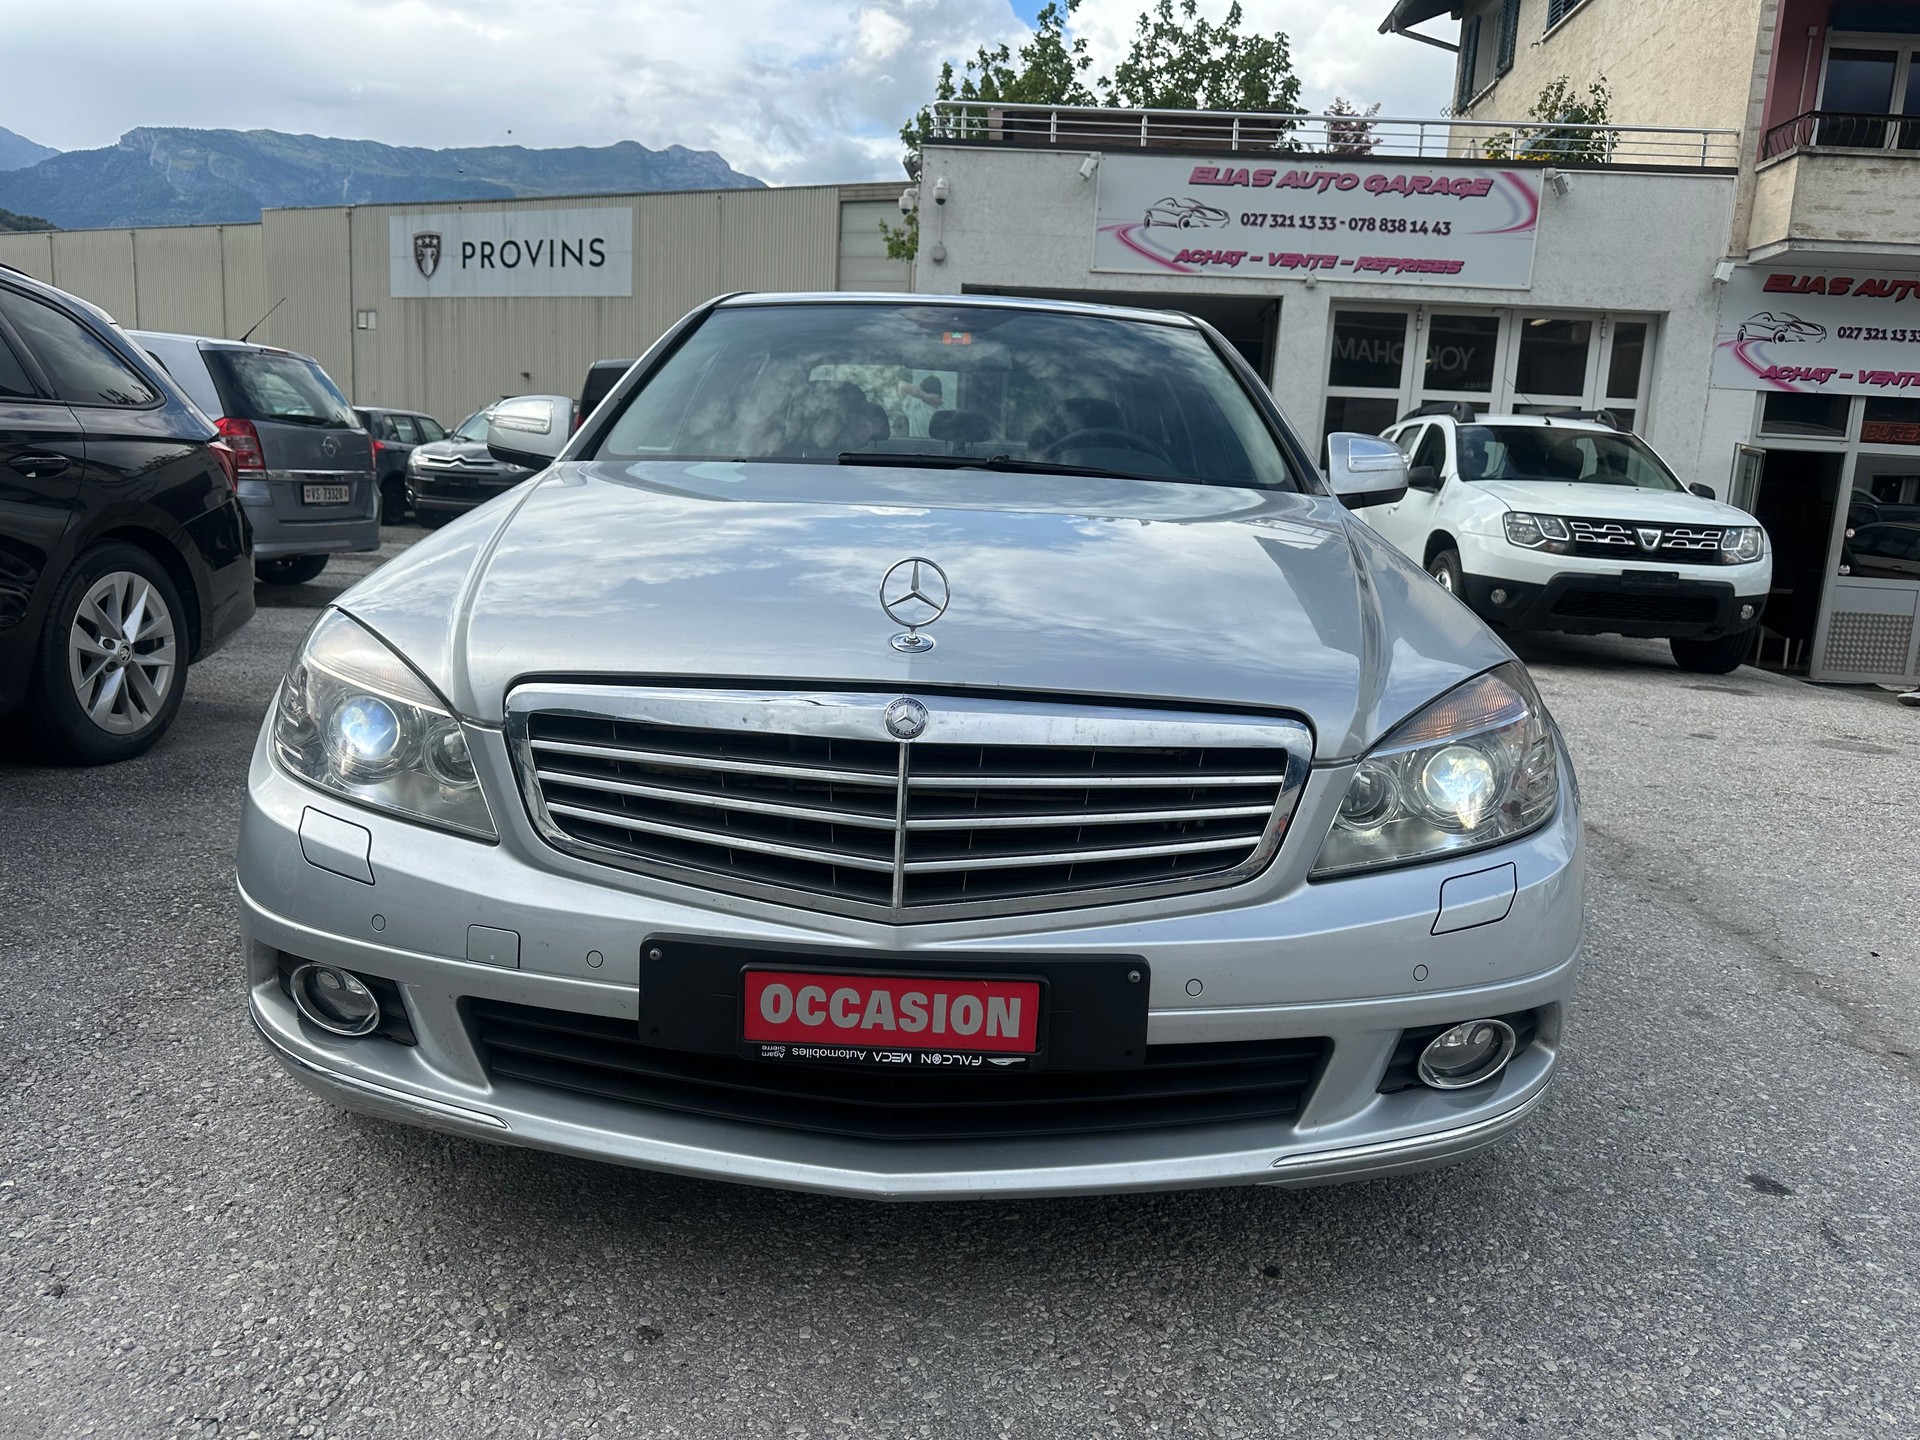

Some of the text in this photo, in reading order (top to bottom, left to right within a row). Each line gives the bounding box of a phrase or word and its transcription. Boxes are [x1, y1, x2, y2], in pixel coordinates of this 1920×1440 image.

[1188, 166, 1494, 200] ELIAS AUTO GARAGE
[1240, 212, 1267, 228] 027
[1269, 214, 1296, 229] 321
[1298, 215, 1316, 230] 13
[1318, 216, 1337, 231] 33
[1348, 217, 1376, 232] 078
[1379, 218, 1407, 233] 838
[1409, 220, 1429, 235] 14
[1431, 221, 1452, 236] 43
[461, 237, 606, 269] PROVINS
[1172, 248, 1248, 268] ACHAT
[1268, 252, 1339, 272] VENTE
[1353, 255, 1465, 275] REPRISES
[1762, 273, 1855, 297] ELIAS
[1837, 326, 1862, 340] 027
[1863, 327, 1888, 341] 321
[1890, 329, 1907, 342] 13
[1759, 365, 1838, 385] ACHAT
[760, 983, 1022, 1038] OCCASION
[792, 1047, 867, 1061] Automobiles
[873, 1051, 912, 1063] MECA
